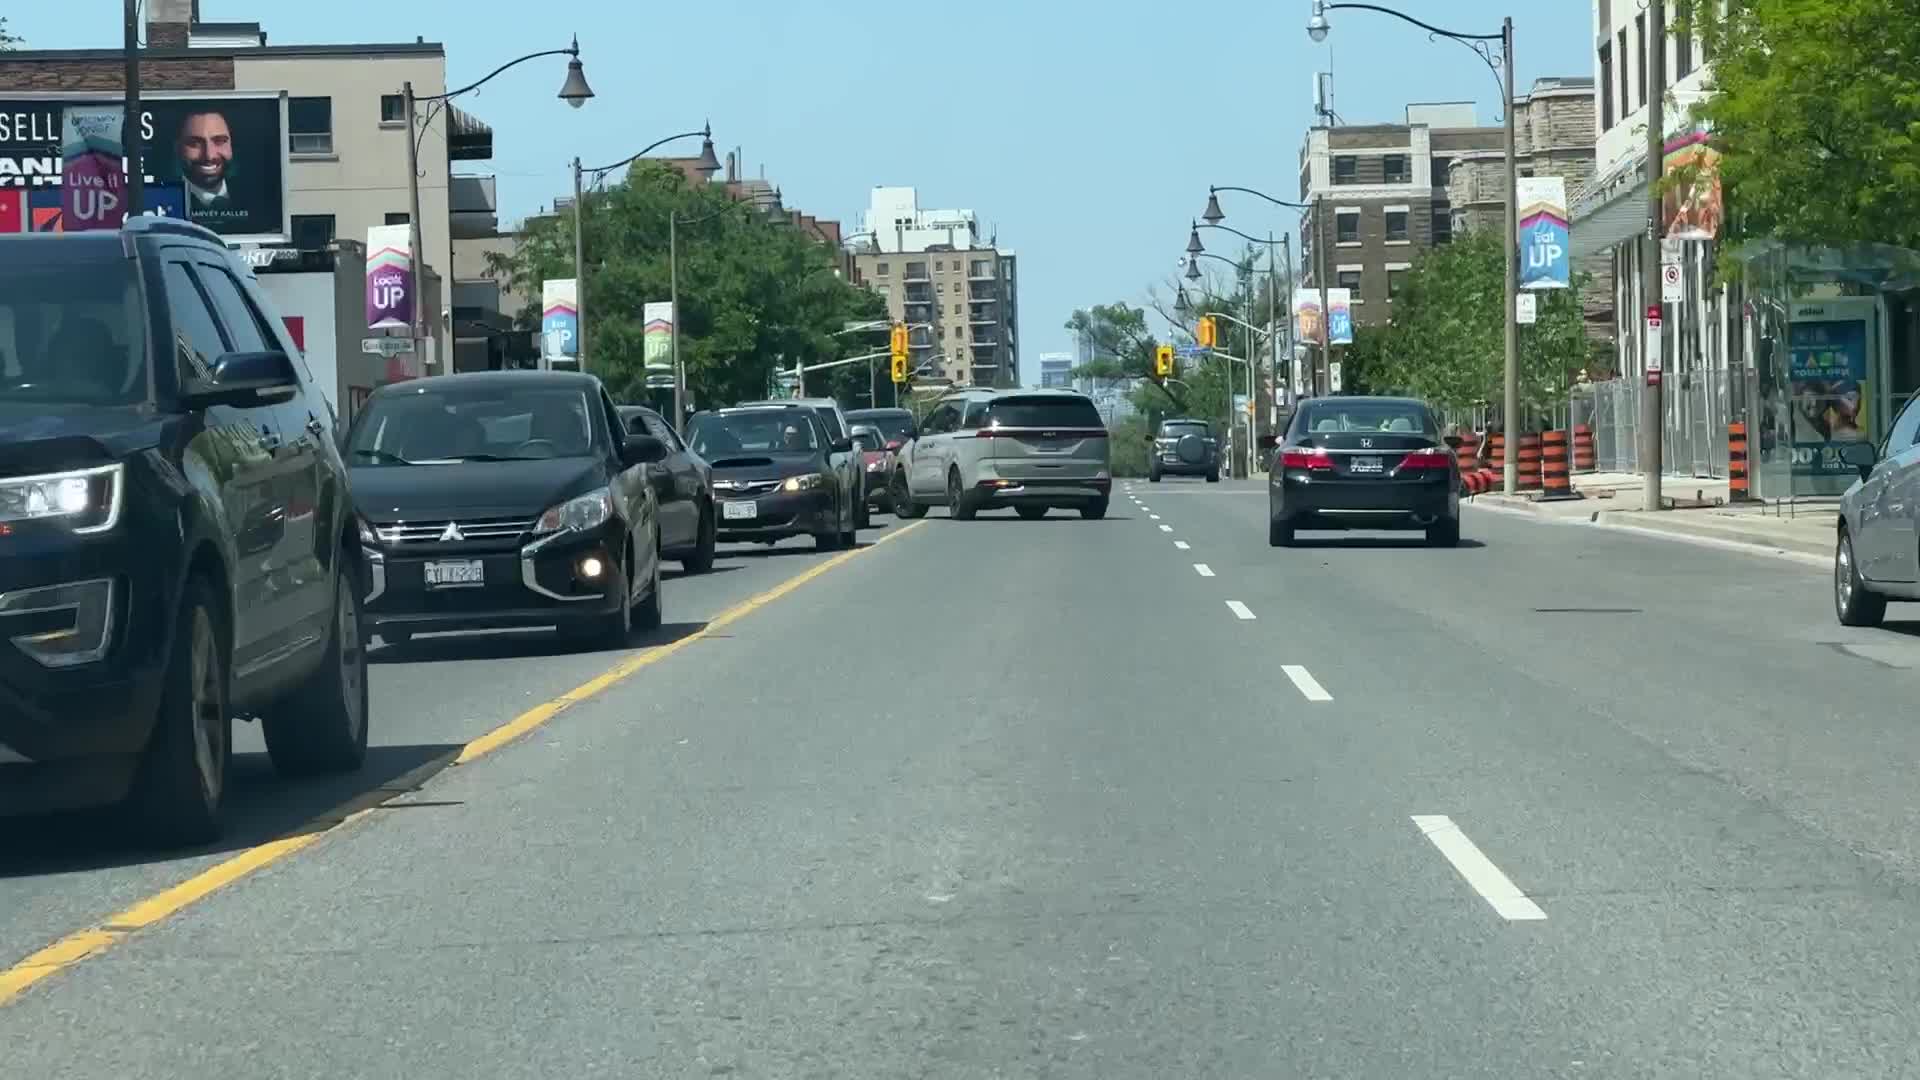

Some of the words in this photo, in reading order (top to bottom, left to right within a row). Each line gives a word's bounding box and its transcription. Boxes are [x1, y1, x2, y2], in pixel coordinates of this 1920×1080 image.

[70, 172, 104, 187] Live
[108, 173, 118, 188] it
[73, 189, 118, 221] UP
[1534, 231, 1554, 243] Eat
[1529, 244, 1562, 267] UP
[373, 286, 404, 309] UP
